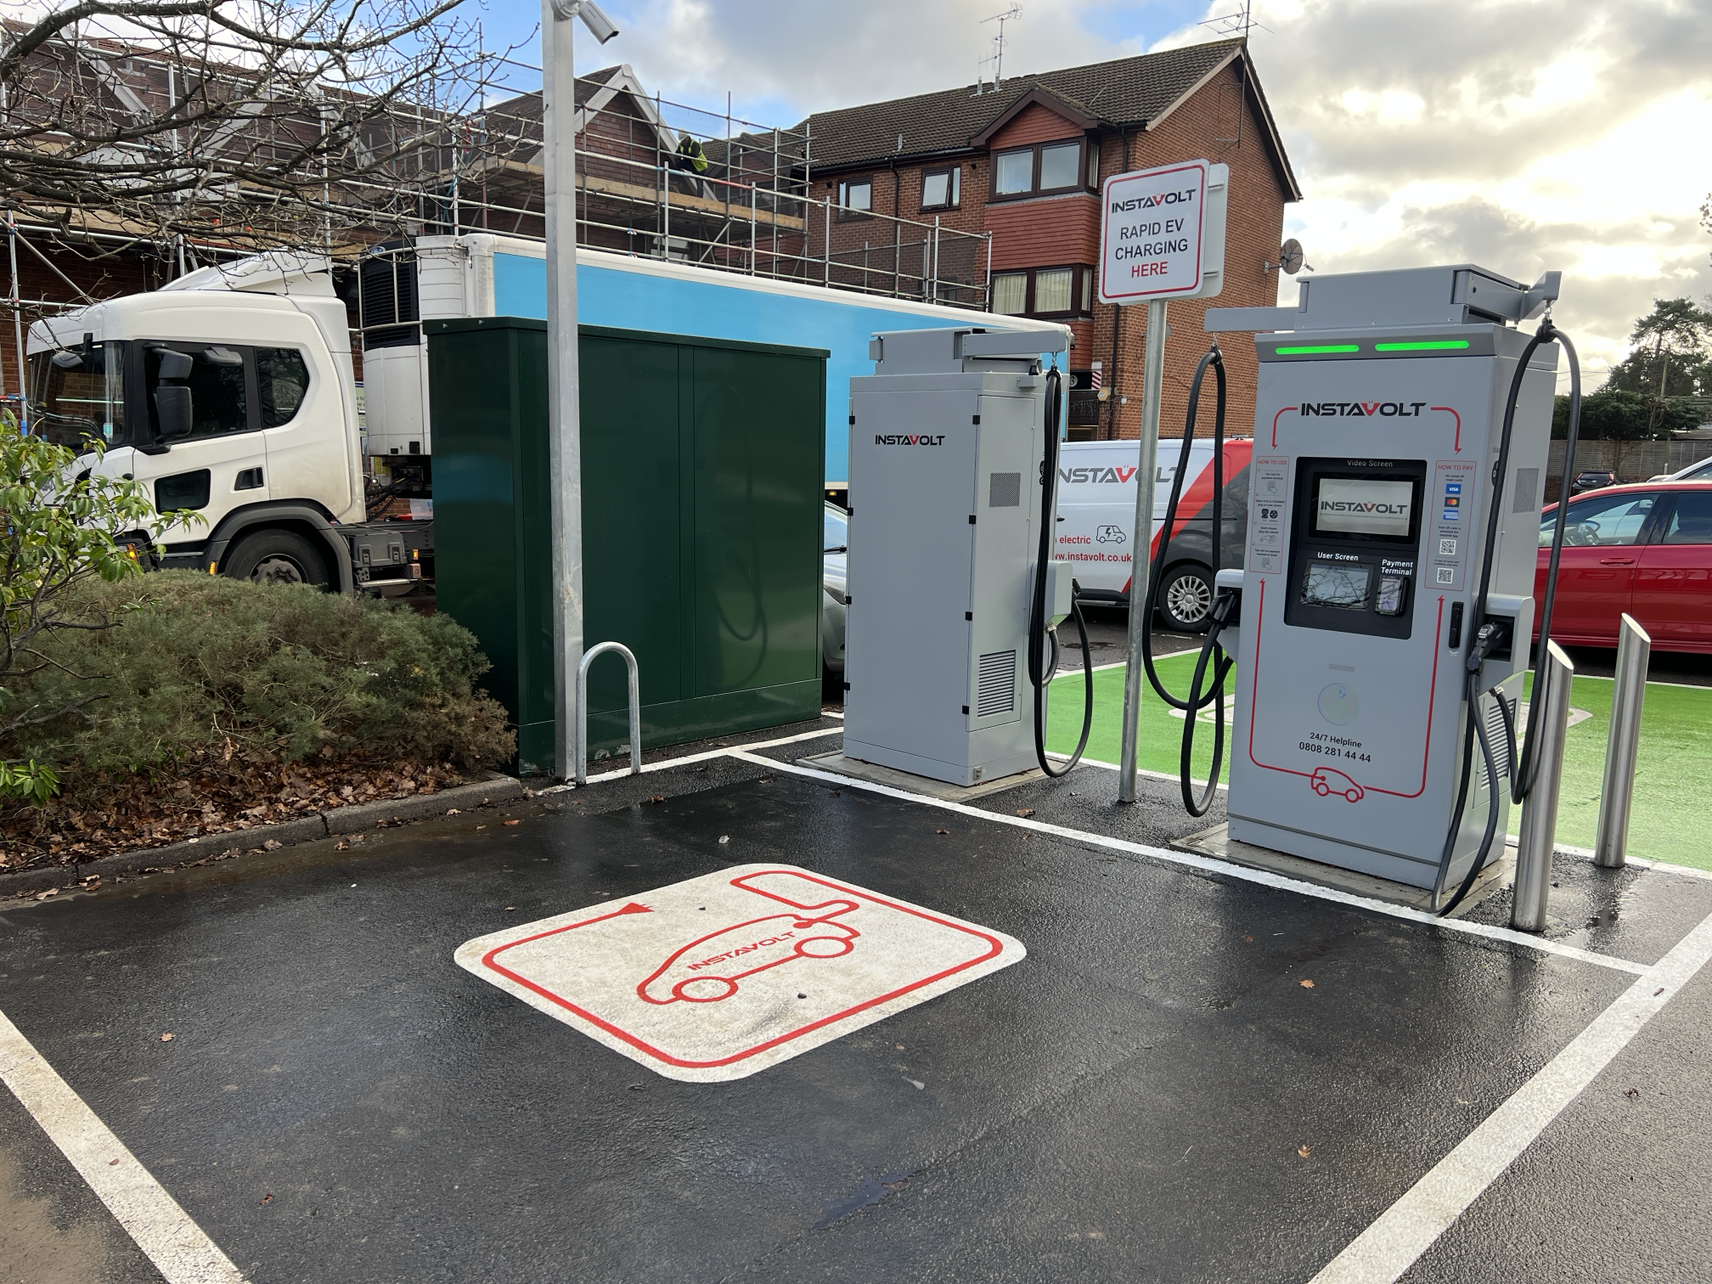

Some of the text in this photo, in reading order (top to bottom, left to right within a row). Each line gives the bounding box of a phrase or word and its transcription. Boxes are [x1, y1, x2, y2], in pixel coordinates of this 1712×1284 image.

[1111, 189, 1197, 213] INSTAVOLT
[1120, 218, 1184, 240] RAPID EV
[1115, 238, 1188, 260] CHARGING
[1131, 261, 1168, 278] HERE
[1301, 401, 1427, 416] INSTAVOLT
[875, 434, 946, 446] INSTAVOLT
[1058, 465, 1178, 483] NSTAVL
[1321, 501, 1408, 514] INSTAVOLT
[1059, 535, 1091, 544] electric
[1054, 552, 1132, 562] ww.instavolt.co.uk
[1335, 553, 1359, 561] Screen
[1381, 559, 1414, 568] Payment
[1381, 567, 1412, 576] Terminal
[1310, 732, 1362, 748] 24/7 Helpline
[1299, 741, 1371, 763] 0808 281 44 44
[686, 931, 796, 970] INSTAVOLT
